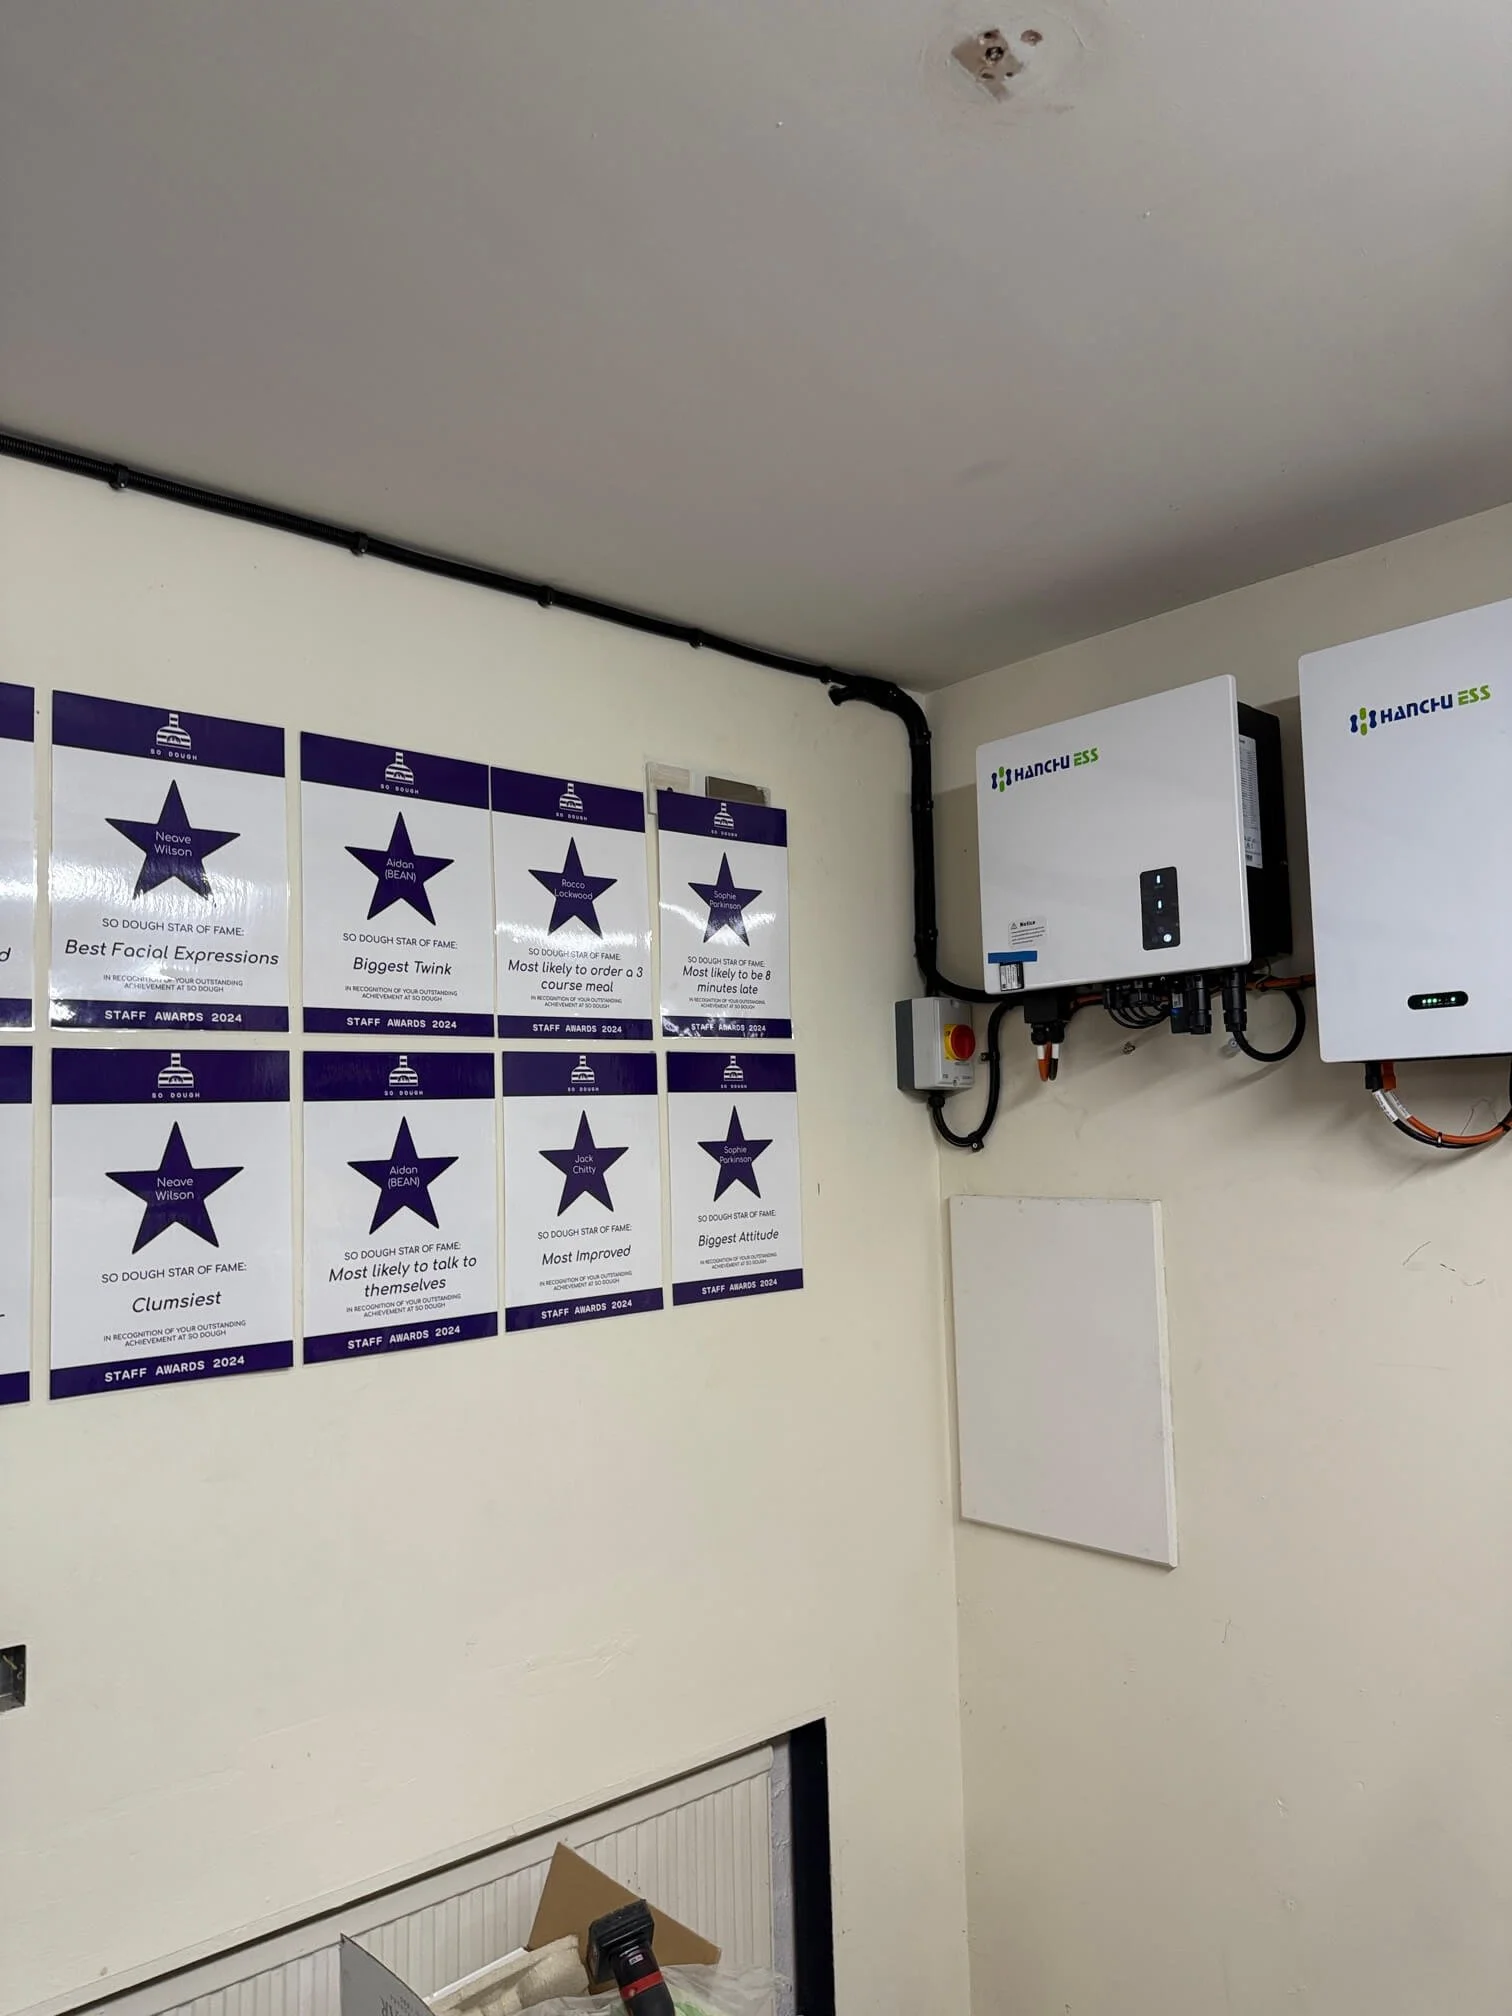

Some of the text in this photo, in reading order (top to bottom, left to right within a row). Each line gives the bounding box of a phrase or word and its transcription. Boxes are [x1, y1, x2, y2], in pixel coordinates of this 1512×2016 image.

[1381, 685, 1491, 724] HANCHU ESS
[169, 751, 197, 760] DOUGH
[1015, 748, 1099, 781] HANCHU ESS
[155, 831, 191, 844] Neave
[154, 844, 192, 856] Wilson
[386, 858, 414, 869] Aidan
[385, 869, 416, 882] (BEAN)
[562, 879, 585, 889] Rocco
[554, 889, 593, 899] Lockwood
[714, 890, 736, 900] Sophie
[710, 900, 742, 910] Parkinson
[102, 918, 244, 936] SO DOUGH STAR OF FAME:
[343, 933, 458, 949] SO DOUGH STAR OF FAME:
[65, 939, 279, 965] Best Facial Expressions
[529, 948, 539, 956] SO
[542, 949, 569, 958] DOUGH
[571, 951, 588, 959] STAR
[353, 957, 452, 975] Biggest Twink
[508, 959, 643, 978] Most likely to order a 3
[683, 966, 771, 981] Most likely to be 8
[195, 978, 243, 986] OUTSTANDING
[541, 980, 614, 992] course meal
[697, 982, 758, 994] minutes late
[104, 1010, 242, 1022] STAFF AWARDS 2024
[347, 1018, 457, 1028] STAFF AWARDS 2024
[566, 1025, 597, 1033] AWARDS
[602, 1025, 622, 1033] 2024
[691, 1023, 714, 1031] STAFF
[724, 1146, 747, 1154] Sophie
[575, 1155, 593, 1163] Jack
[390, 1166, 418, 1175] Aidan
[573, 1166, 596, 1174] Chitty
[157, 1177, 193, 1187] Neave
[388, 1177, 420, 1189] (BEAN)
[155, 1190, 194, 1201] Wilson
[709, 1213, 732, 1221] DOUGH
[538, 1232, 549, 1240] SO
[551, 1229, 579, 1238] DOUGH
[581, 1227, 598, 1235] STAR
[611, 1224, 632, 1232] FAME:
[698, 1228, 779, 1248] Biggest Attitude
[344, 1242, 461, 1260] SO DOUGH STAR OF FAME:
[542, 1245, 631, 1265] Most Improved
[102, 1262, 247, 1283] SO DOUGH STAR OF FAME:
[329, 1256, 477, 1282] Most likely to talk to
[364, 1277, 446, 1297] themselves
[702, 1279, 777, 1294] STAFF AWARDS 2024
[132, 1291, 222, 1313] Clumsiest
[354, 1302, 395, 1312] RECOGNITION
[364, 1308, 406, 1318] ACHIEVEMENT
[425, 1302, 445, 1310] DOUGH
[541, 1300, 632, 1319] STAFF AWARDS 2024
[113, 1329, 163, 1341] RECOGNITION
[176, 1325, 196, 1333] YOUR
[198, 1320, 246, 1331] OUTSTANDING
[125, 1336, 177, 1346] ACHIEVEMENT
[188, 1332, 199, 1340] SO
[200, 1330, 226, 1338] DOUGH
[348, 1326, 460, 1349] STAFF AWARDS 2024
[105, 1356, 245, 1382] STAFF AWARDS 2024
